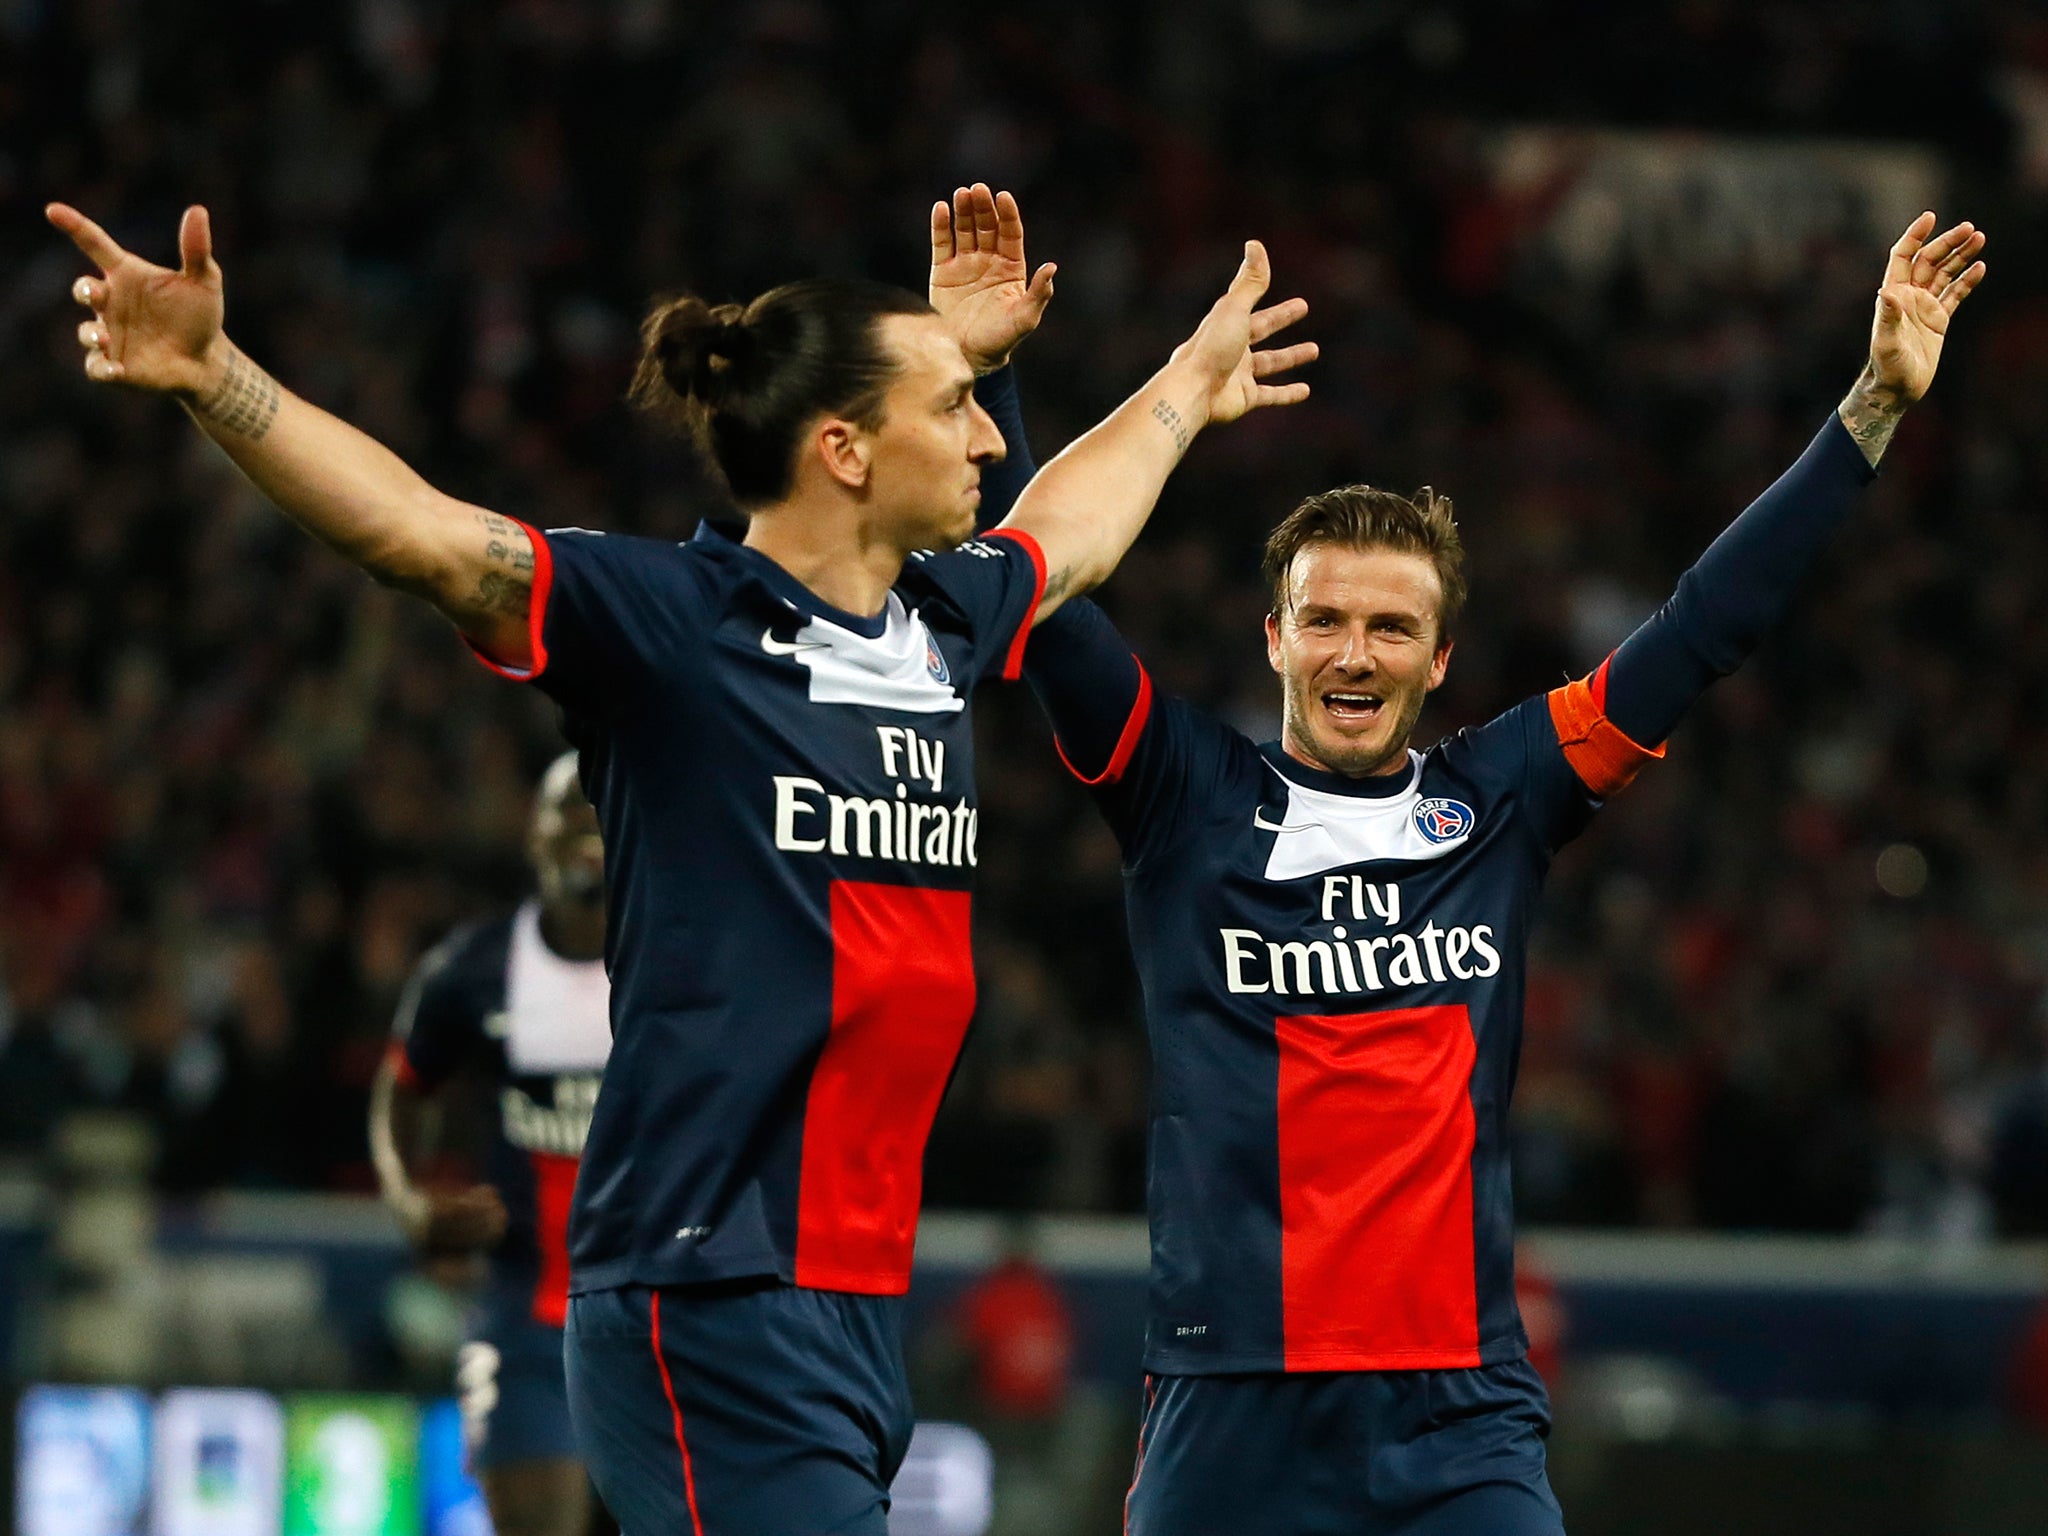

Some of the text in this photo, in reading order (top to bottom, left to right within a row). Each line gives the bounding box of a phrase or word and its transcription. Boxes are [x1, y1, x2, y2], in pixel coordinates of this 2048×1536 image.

[875, 725, 944, 792] Fly
[1416, 800, 1449, 818] PARIS
[1321, 875, 1401, 926] Fly
[1219, 919, 1501, 994] Emirates
[1176, 1325, 1207, 1336] DRI-FIT
